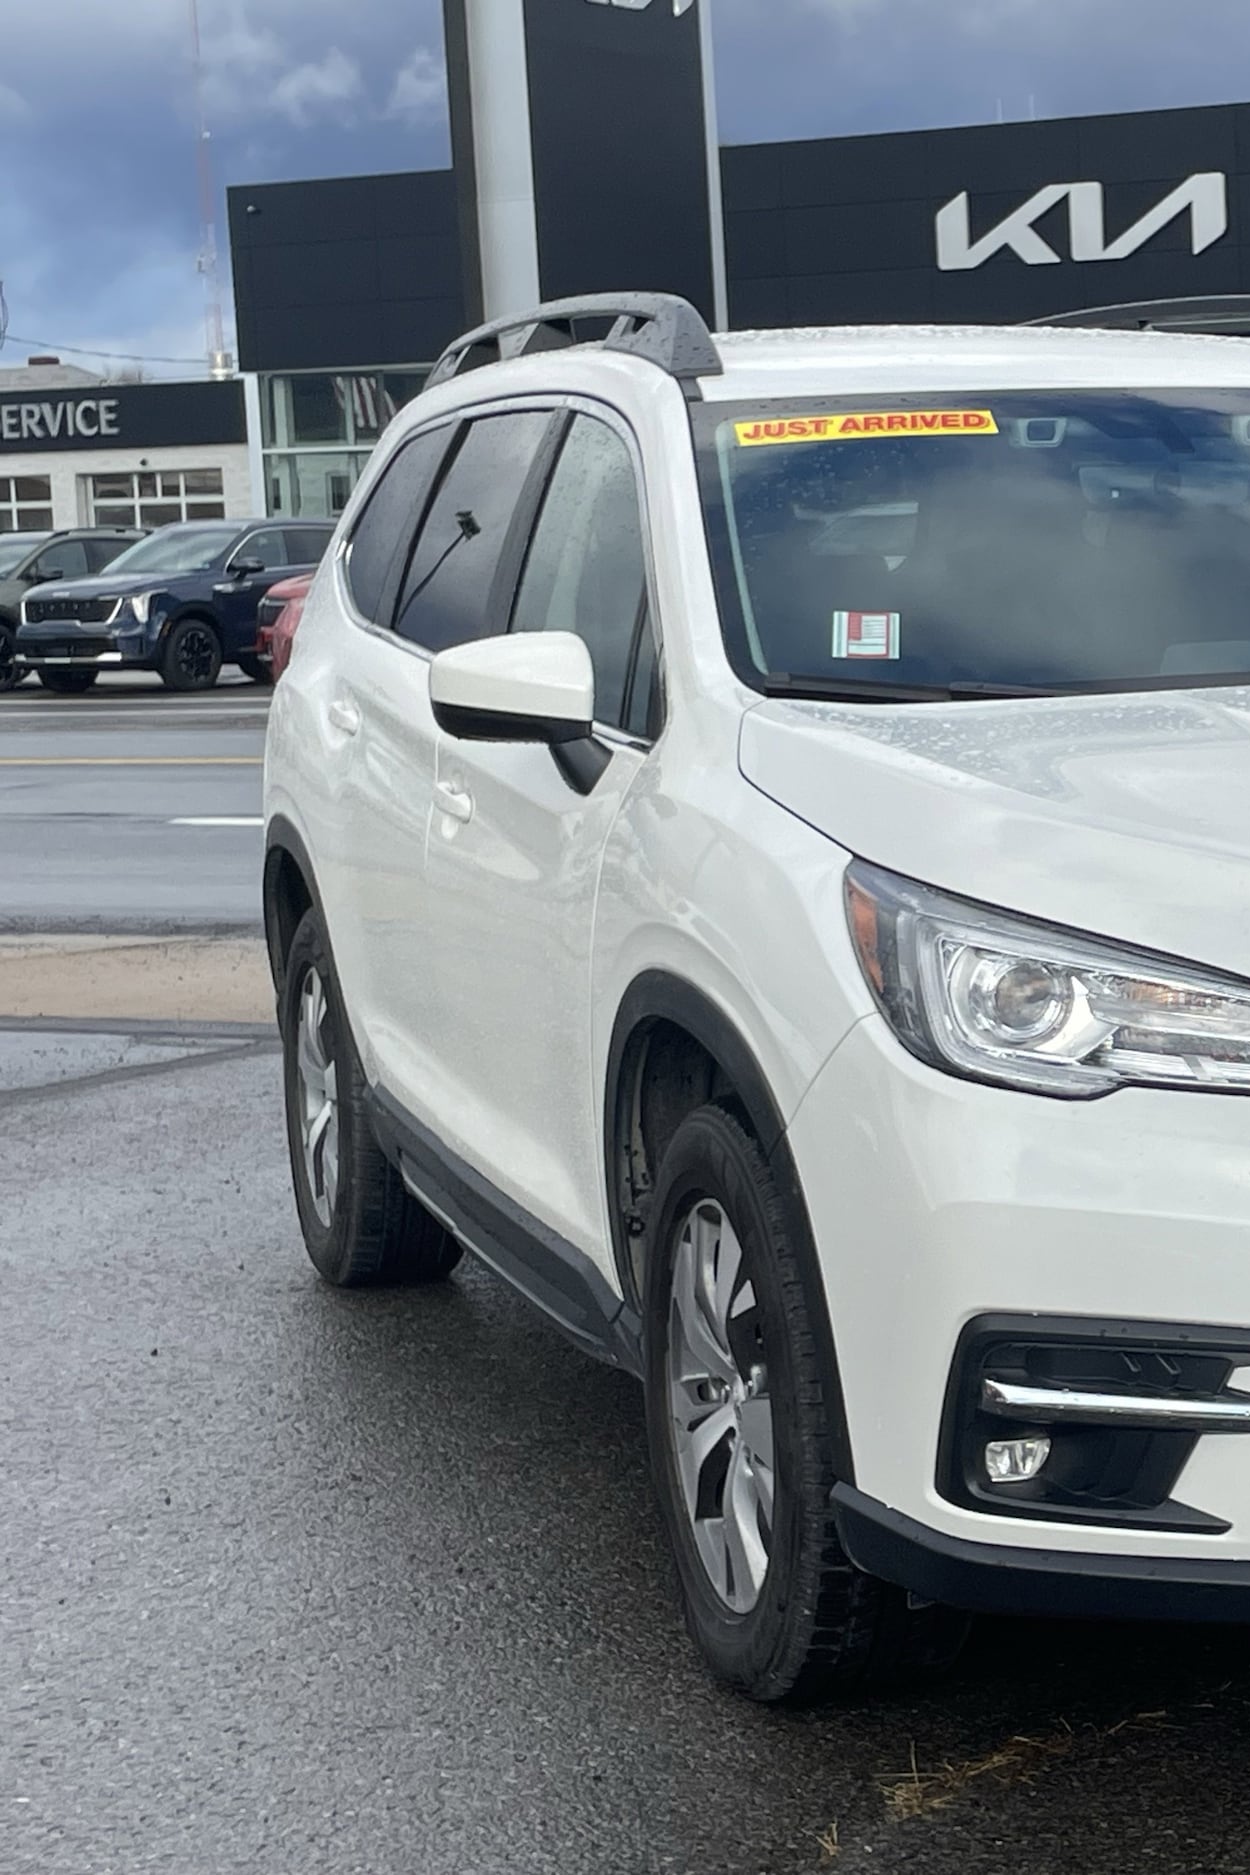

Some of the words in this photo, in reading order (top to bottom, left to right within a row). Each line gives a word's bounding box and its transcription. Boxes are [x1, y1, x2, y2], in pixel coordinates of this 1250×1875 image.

[935, 171, 1227, 271] KIA
[0, 399, 120, 440] ERVICE
[743, 419, 832, 440] JUST
[838, 413, 989, 434] ARRIVED
